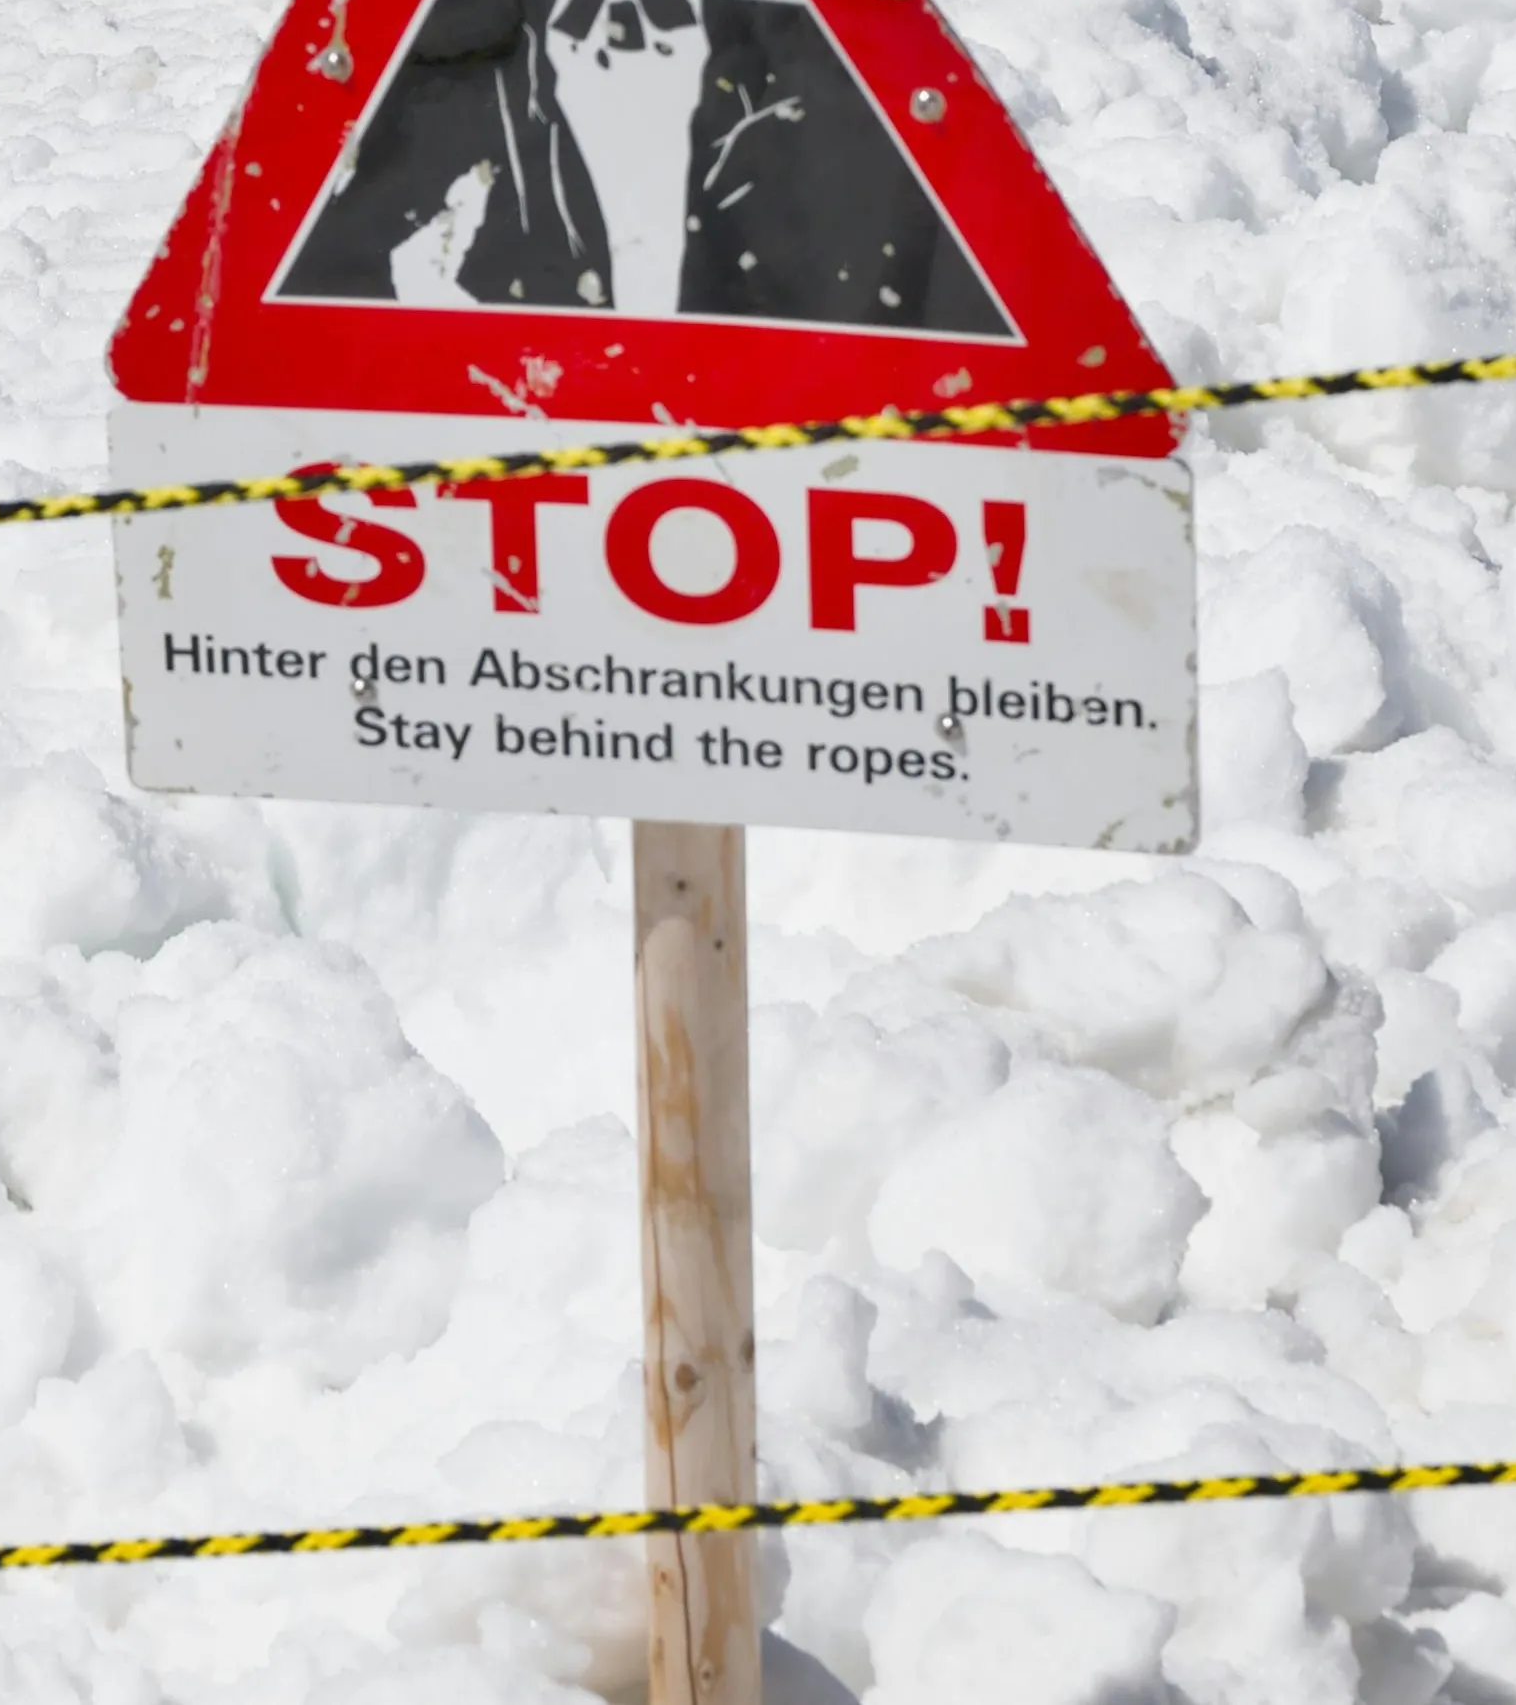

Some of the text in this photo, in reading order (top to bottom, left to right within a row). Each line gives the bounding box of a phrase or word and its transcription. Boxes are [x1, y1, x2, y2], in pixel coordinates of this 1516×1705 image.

[271, 461, 1030, 644] STOP!
[163, 632, 1158, 729] Hinter den Abschrankungen bleiben.
[354, 704, 969, 785] Stay behind the ropes.
